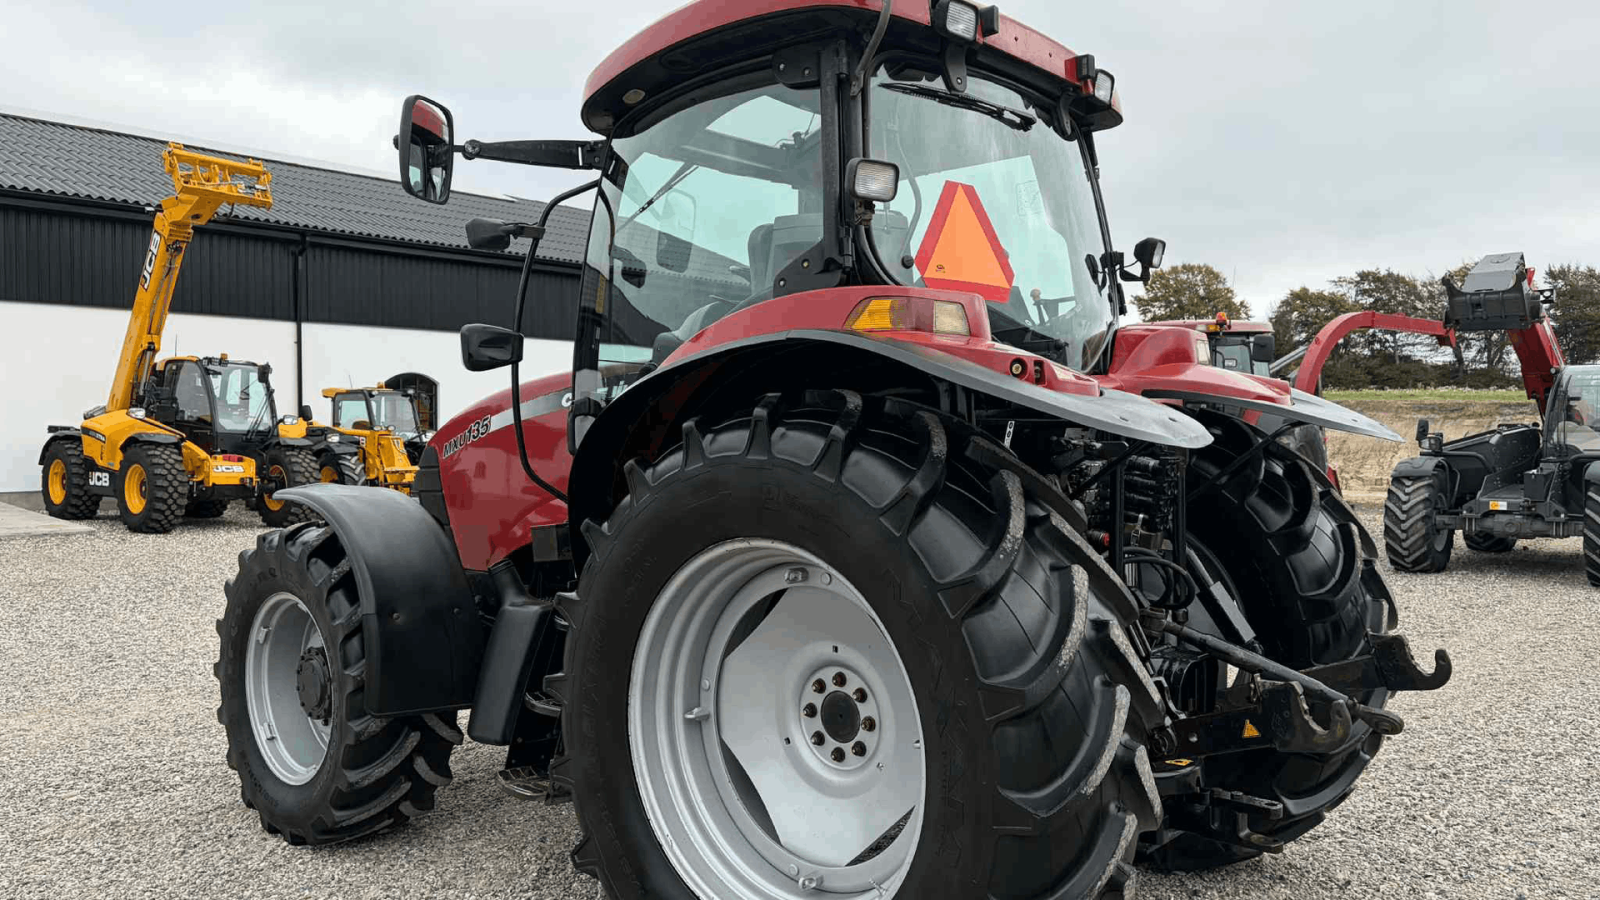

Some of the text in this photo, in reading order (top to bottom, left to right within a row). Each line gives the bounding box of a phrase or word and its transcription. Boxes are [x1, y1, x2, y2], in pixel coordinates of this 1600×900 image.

[141, 231, 161, 290] JCB
[443, 415, 491, 459] MXU135
[89, 471, 110, 486] JCB
[213, 465, 245, 473] JCB
